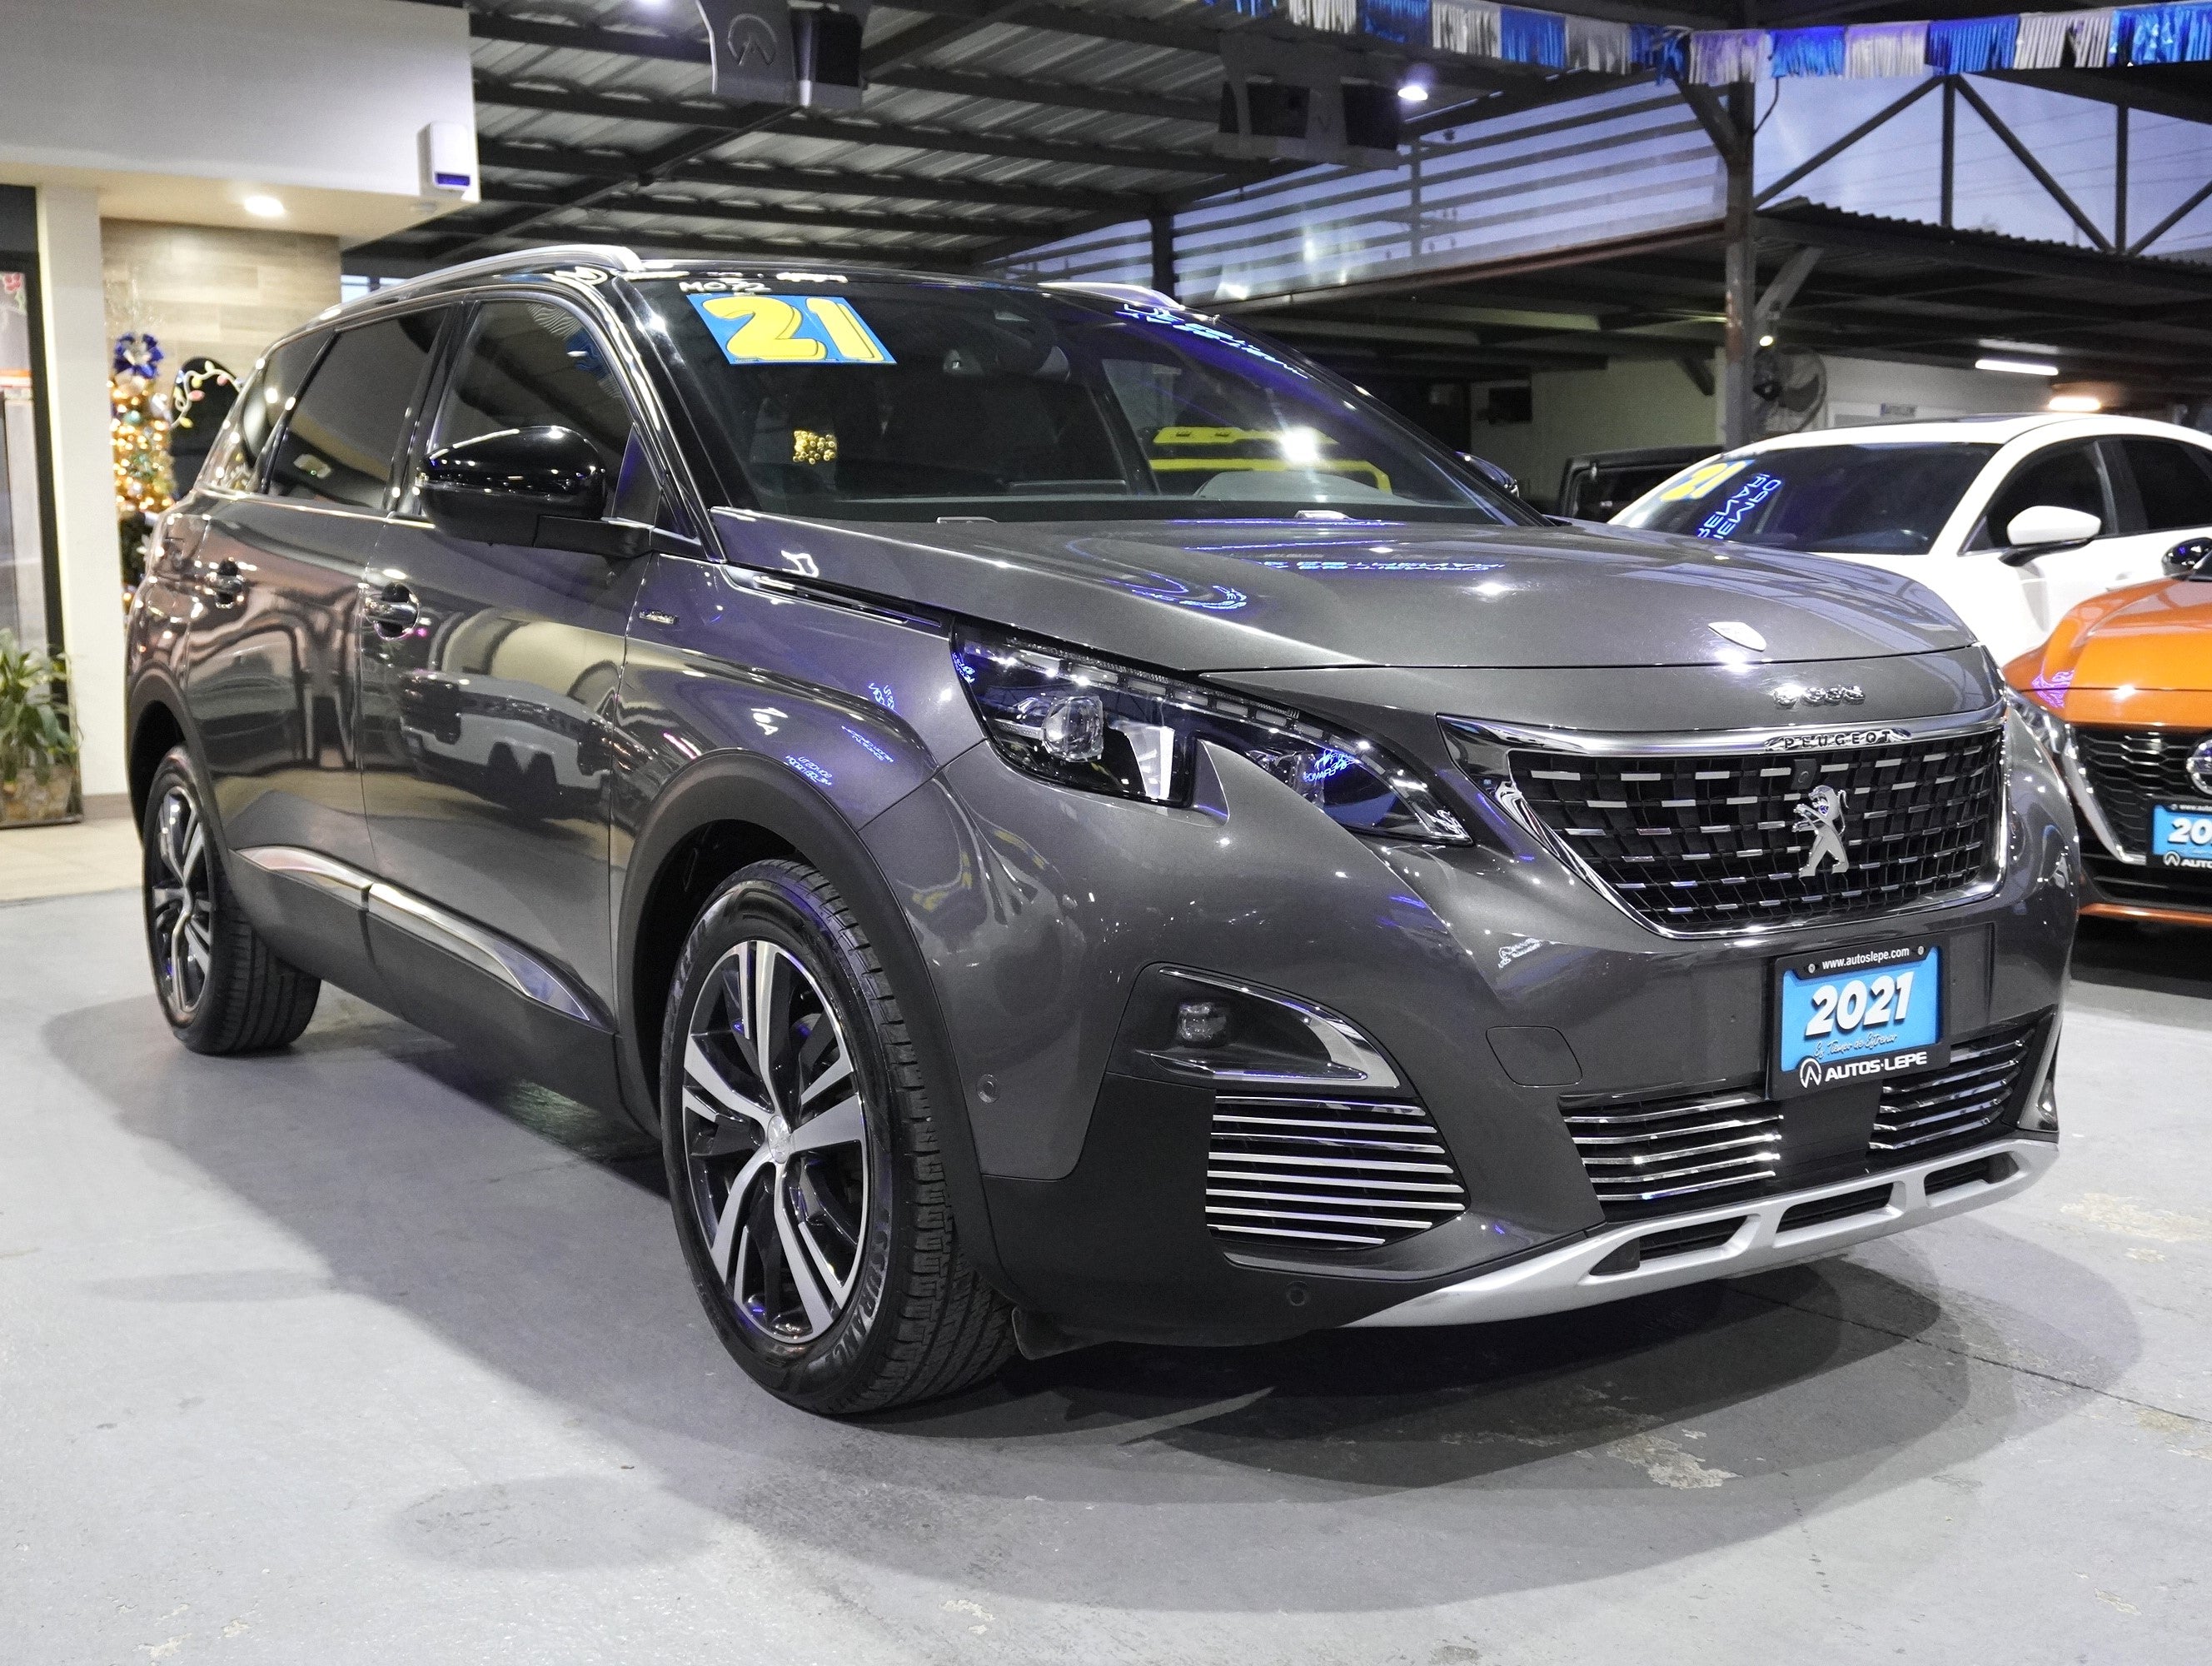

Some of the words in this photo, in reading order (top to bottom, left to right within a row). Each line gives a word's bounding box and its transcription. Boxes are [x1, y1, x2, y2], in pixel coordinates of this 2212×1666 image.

[701, 296, 885, 361] 21
[1784, 731, 1891, 749] PEUGEOT
[2168, 817, 2212, 845] 20
[1821, 948, 1910, 970] www.autoslepe.com
[1806, 970, 1915, 1036] 2021
